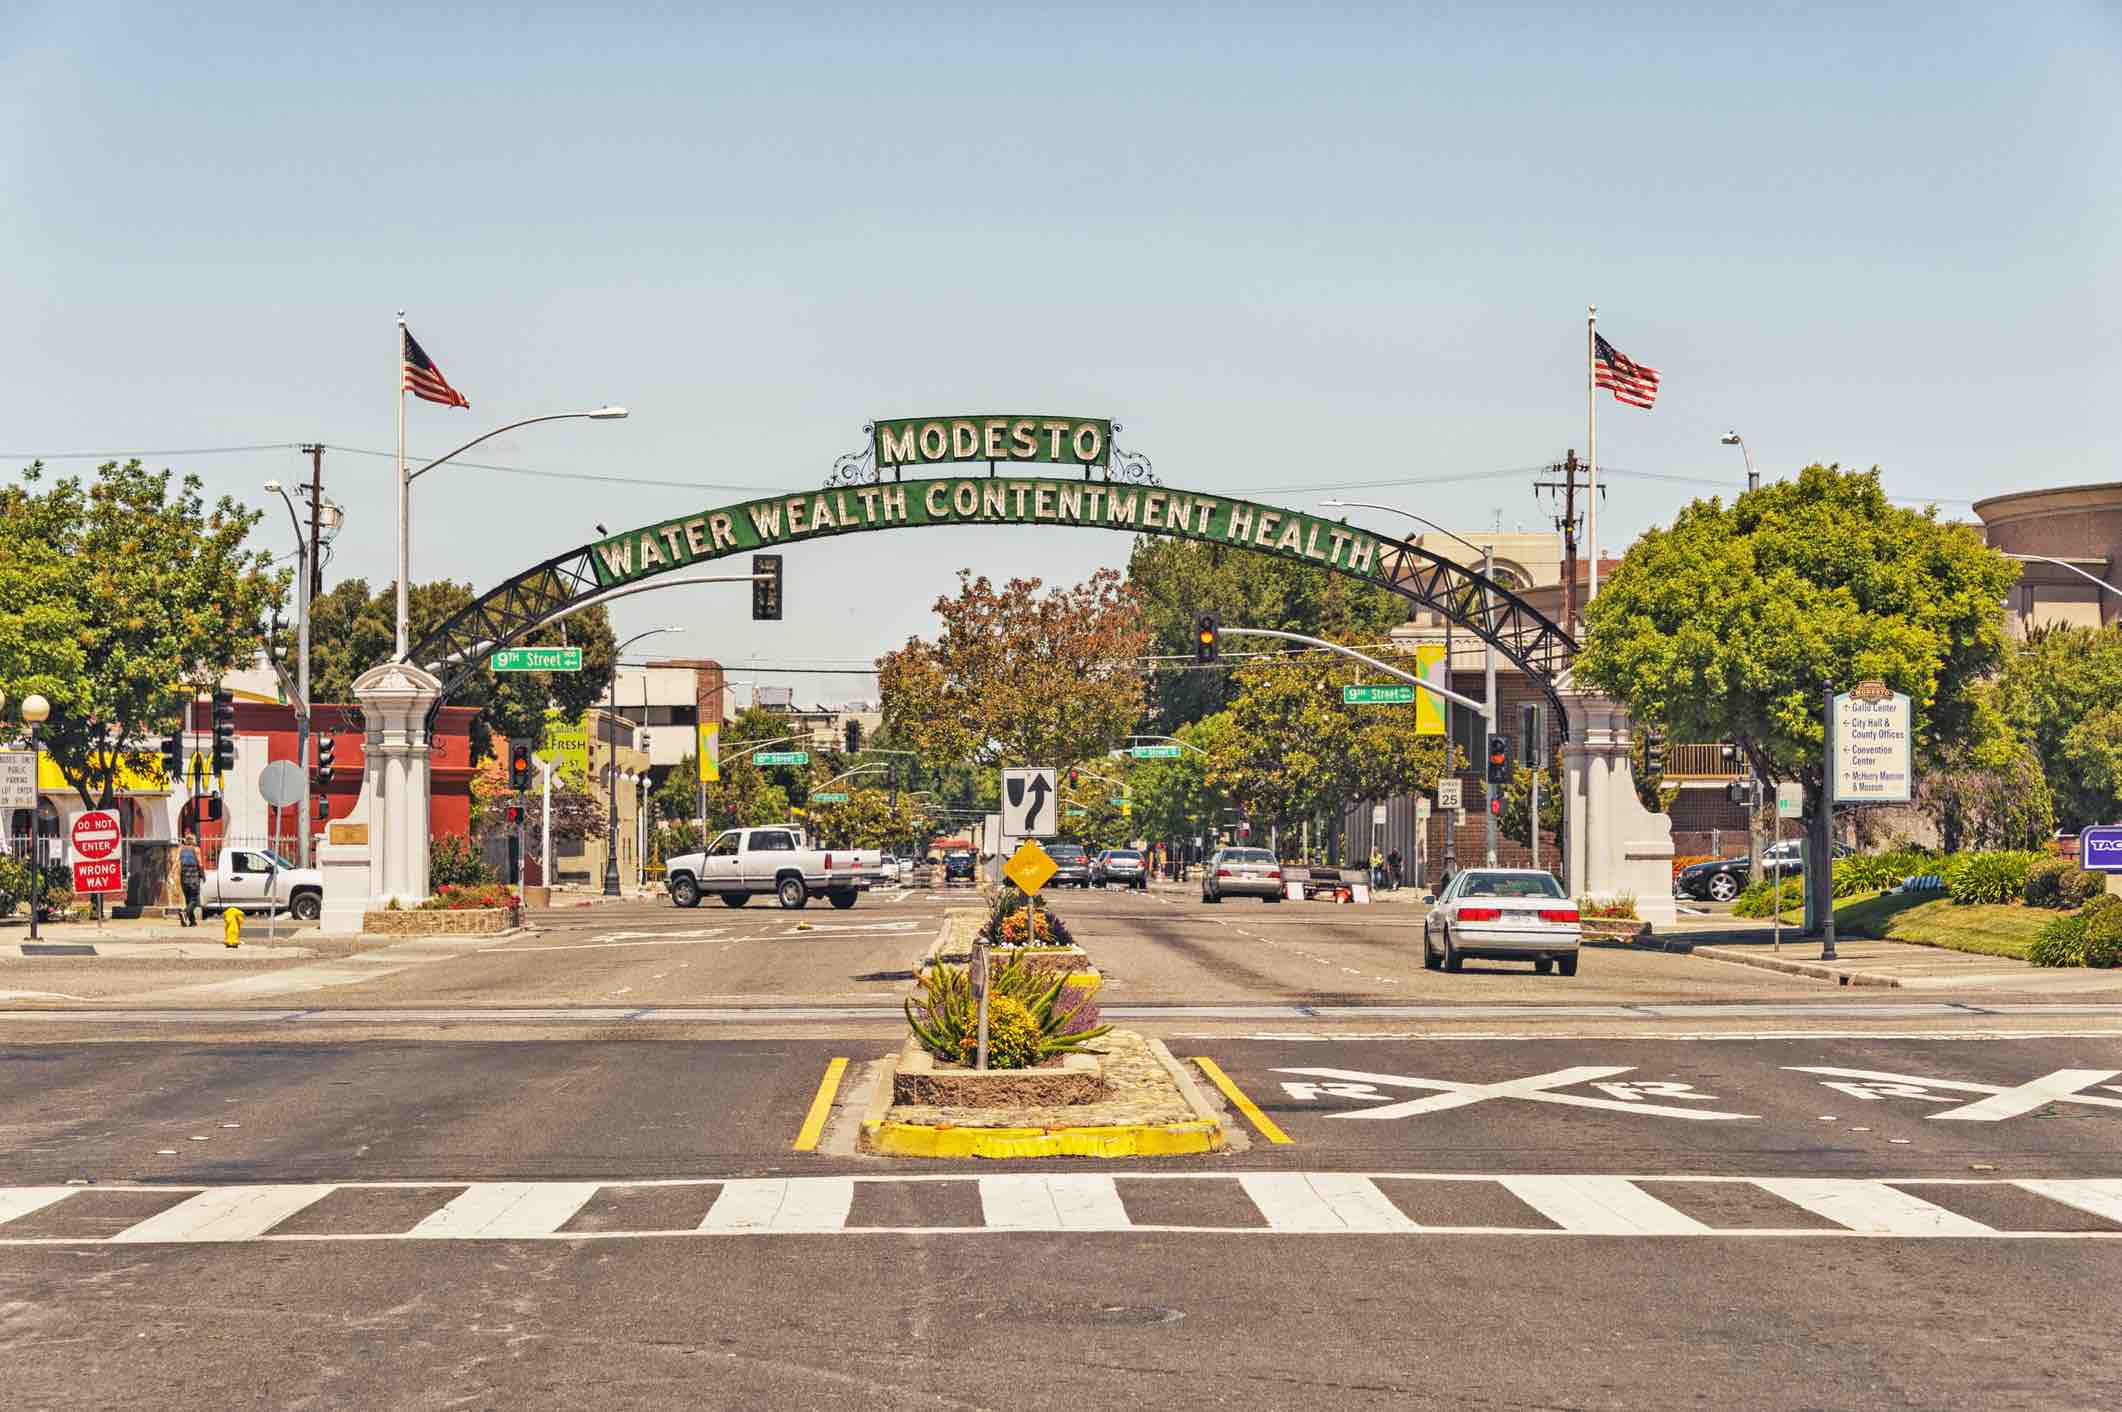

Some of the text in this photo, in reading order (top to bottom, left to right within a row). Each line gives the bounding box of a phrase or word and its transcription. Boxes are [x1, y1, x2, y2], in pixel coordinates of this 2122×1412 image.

[881, 421, 1102, 463] MODESTO
[600, 481, 1379, 578] WATER WEALTH CONTENTMENT HEALTH
[527, 652, 561, 666] Street
[1371, 688, 1399, 700] Street
[1852, 702, 1897, 713] Gallo Center
[1852, 718, 1866, 730] City
[1868, 718, 1883, 727] Hall
[1852, 729, 1904, 740] County Offices
[551, 738, 585, 750] FRESH
[1852, 744, 1892, 754] Convention
[1852, 756, 1876, 765] Center
[1442, 794, 1458, 806] 25
[95, 820, 112, 828] NOT
[82, 841, 110, 851] ENTER
[79, 864, 116, 875] WRONG
[86, 877, 109, 887] WAY
